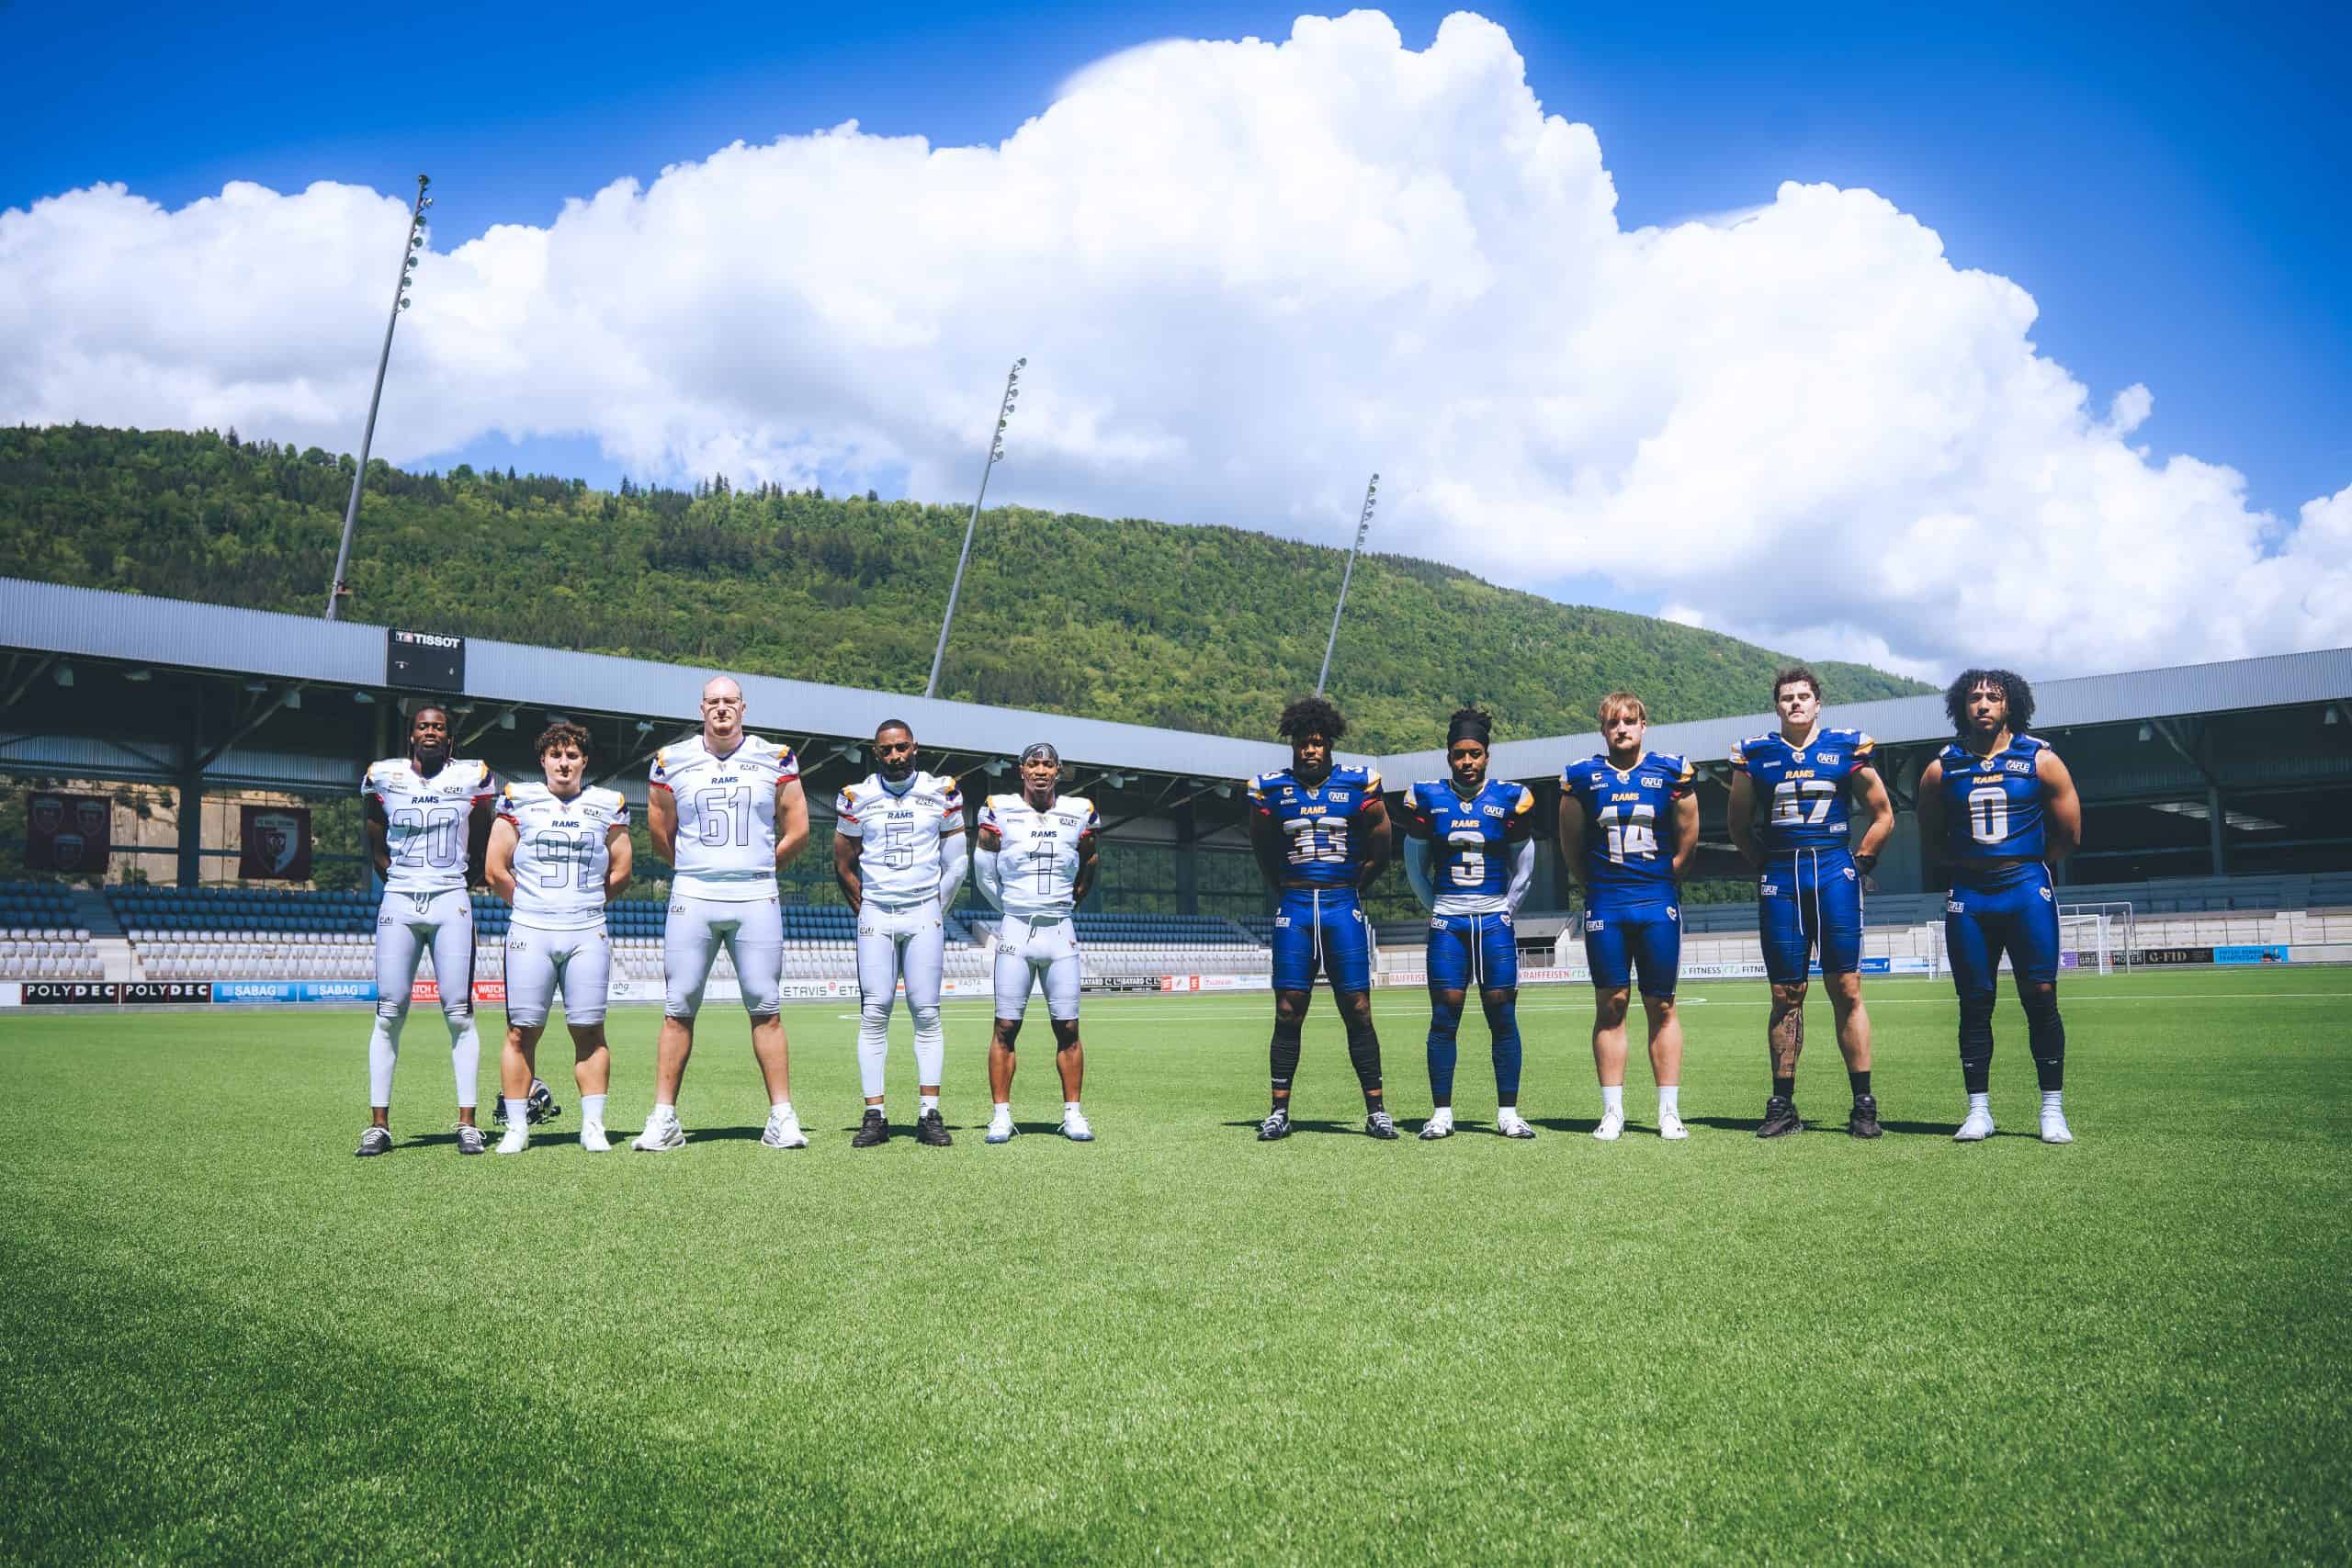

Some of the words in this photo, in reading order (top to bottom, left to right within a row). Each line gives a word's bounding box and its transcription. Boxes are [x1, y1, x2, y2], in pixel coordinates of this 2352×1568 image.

[413, 632, 460, 649] TISSOT
[1785, 770, 1815, 780] RAMS
[711, 776, 739, 785] RAMS
[412, 795, 440, 805] RAMS
[1611, 793, 1640, 802] RAMS
[1770, 781, 1838, 824] 47
[695, 785, 752, 847] 61
[888, 811, 914, 820] RAMS
[1300, 806, 1328, 816] RAMS
[1968, 786, 2008, 844] 0
[551, 820, 580, 829] RAMS
[1450, 819, 1481, 829] RAMS
[392, 807, 460, 868] 20
[1031, 830, 1057, 839] RAMS
[1596, 804, 1658, 864] 14
[884, 822, 914, 871] 5
[536, 830, 595, 889] 91
[1447, 830, 1486, 887] 3
[1029, 841, 1055, 895] 1
[1525, 970, 1569, 979] RAIFFEISEN
[1689, 966, 1721, 975] FITNESS
[1742, 965, 1765, 974] FITNE
[27, 986, 115, 997] POLYDEC
[125, 986, 208, 997] POLYDEC
[234, 985, 276, 996] SABAG
[319, 985, 358, 995] SABAG
[412, 984, 431, 993] ATCH
[784, 987, 827, 997] ETAVIS
